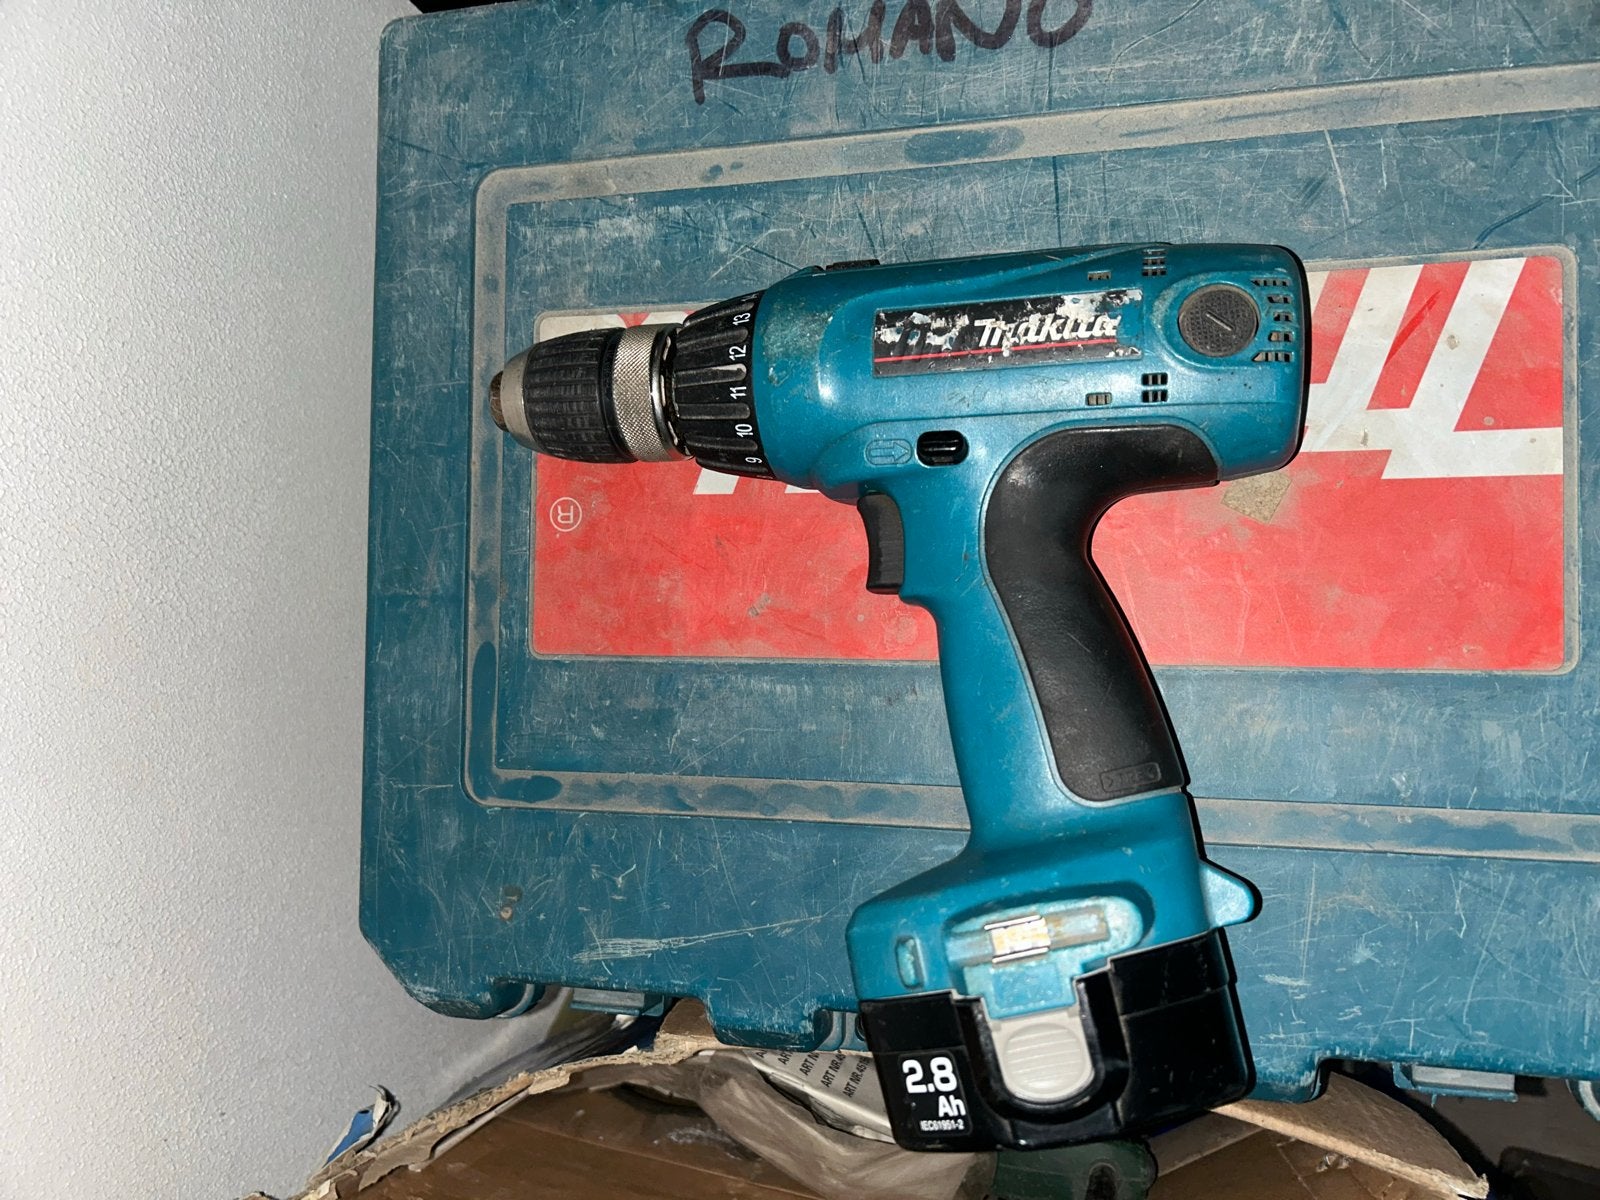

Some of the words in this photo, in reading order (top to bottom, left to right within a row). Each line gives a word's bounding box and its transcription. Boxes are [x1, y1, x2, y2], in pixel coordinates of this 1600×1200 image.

[732, 312, 750, 326] 13
[729, 344, 747, 361] 12
[730, 386, 747, 400] 11
[735, 423, 753, 438] 10
[745, 456, 763, 464] 9
[799, 1058, 816, 1076] ART
[902, 1056, 957, 1093] 2.8
[820, 1070, 836, 1088] ART
[842, 1081, 857, 1098] ART
[938, 1094, 966, 1117] Ah
